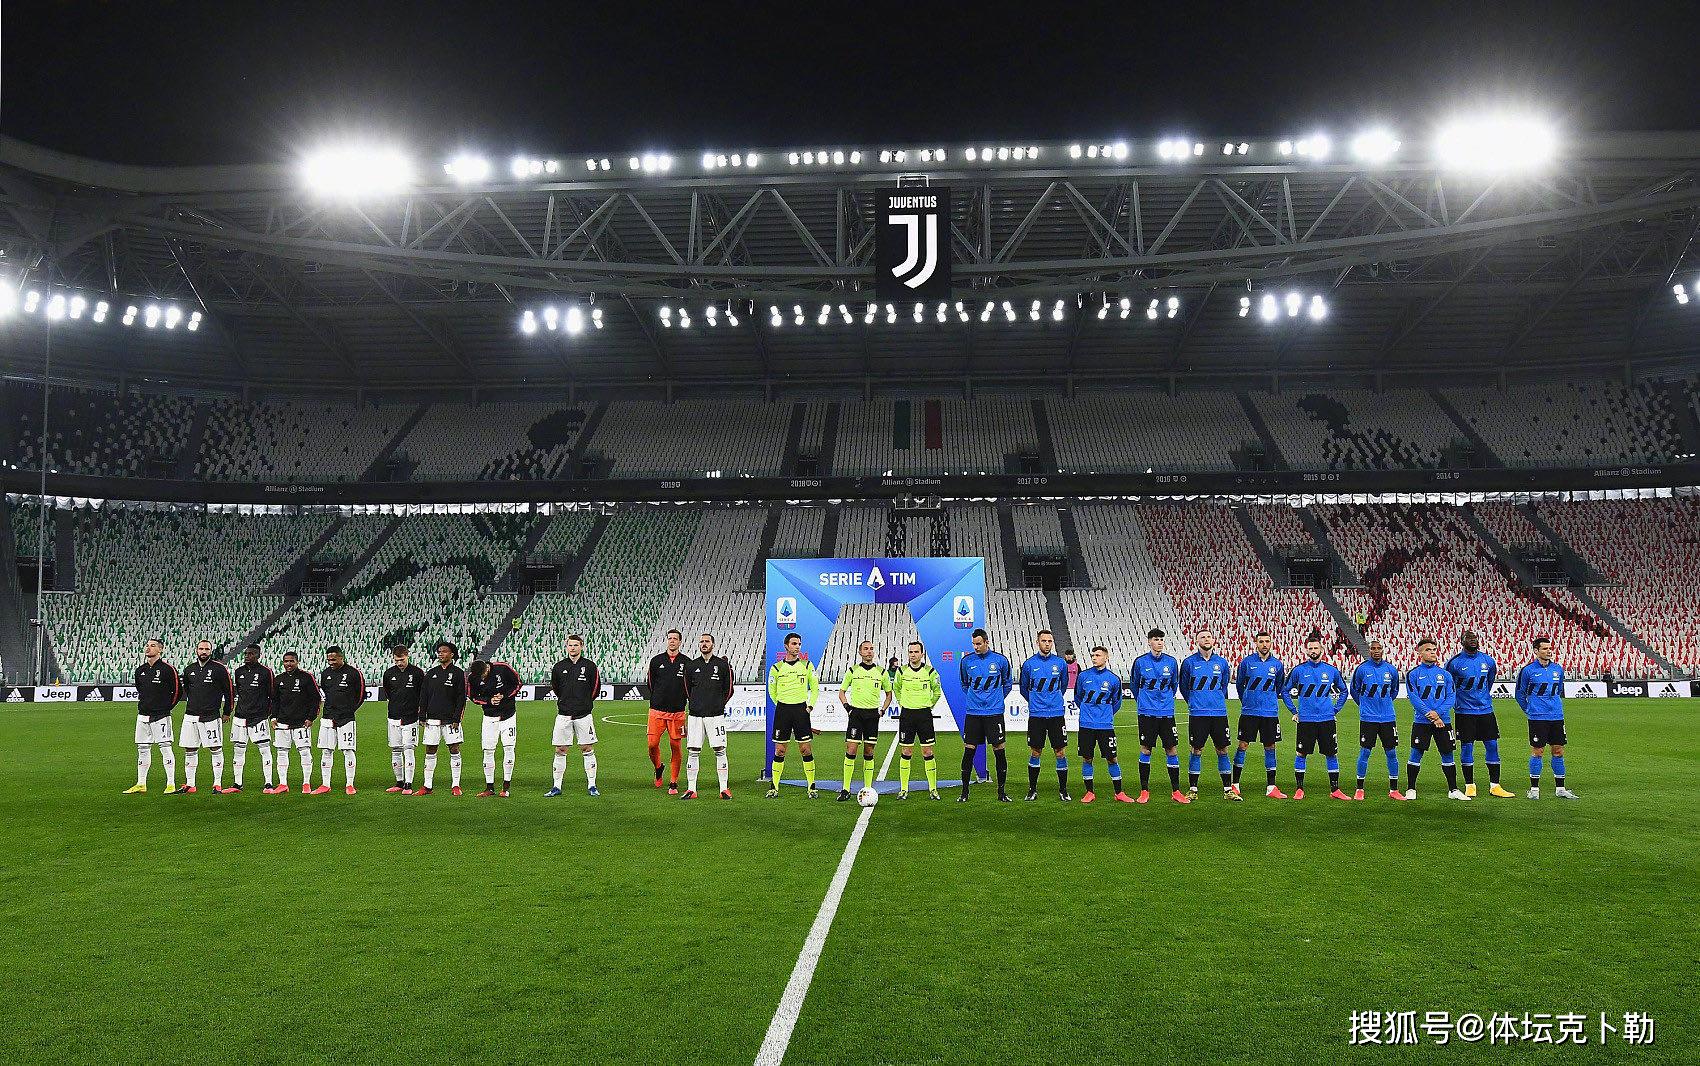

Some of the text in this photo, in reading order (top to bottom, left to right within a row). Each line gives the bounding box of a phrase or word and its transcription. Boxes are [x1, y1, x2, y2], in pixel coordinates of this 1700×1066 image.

[888, 196, 937, 209] JUVENTUS
[1303, 473, 1319, 481] 2015
[1593, 469, 1620, 477] Allianz
[881, 478, 904, 486] Allianz
[1017, 477, 1031, 485] 2017
[1156, 475, 1171, 483] 2016
[660, 481, 675, 489] 2019
[819, 572, 863, 586] SERIE
[889, 572, 916, 586] TIM
[42, 689, 71, 699] Jeep
[118, 689, 139, 698] Jee
[516, 690, 529, 699] ep
[1612, 684, 1643, 697] Jeep
[160, 723, 166, 733] 7
[254, 722, 266, 734] 14
[411, 727, 417, 737] 8
[588, 725, 594, 736] 4
[715, 725, 726, 737] 19
[997, 723, 1003, 734] 1
[206, 729, 218, 740] 21
[298, 728, 309, 740] 11
[343, 732, 353, 742] 12
